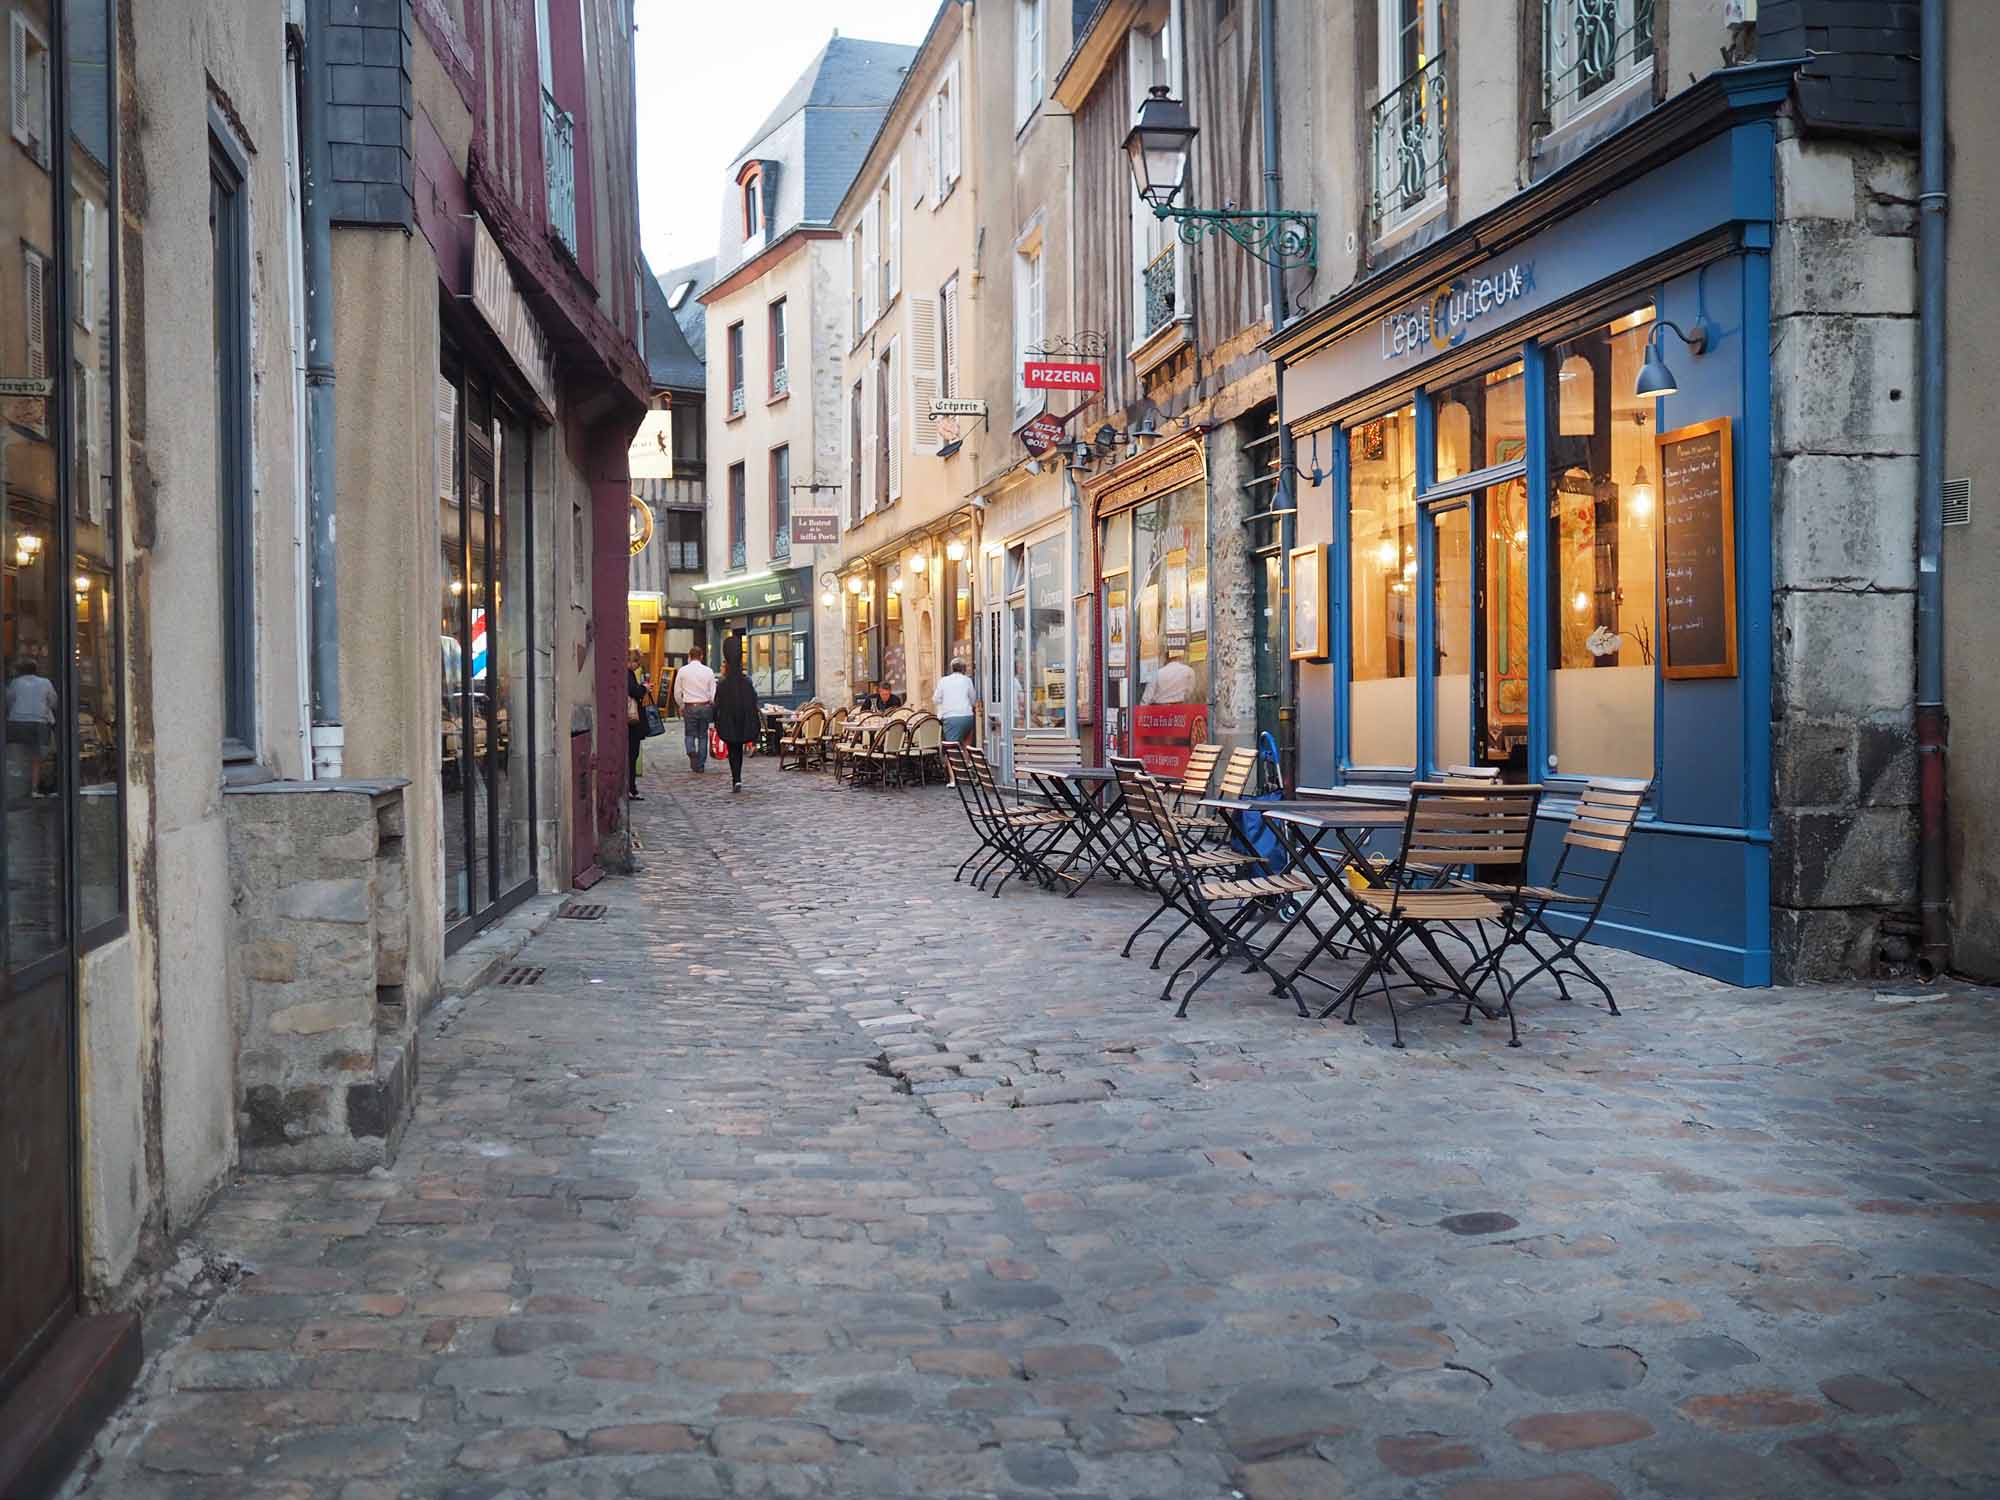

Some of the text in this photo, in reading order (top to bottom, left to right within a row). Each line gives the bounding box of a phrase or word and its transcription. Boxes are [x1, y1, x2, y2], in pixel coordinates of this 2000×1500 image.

[1031, 369, 1096, 383] PIZZERIA
[935, 401, 978, 412] Crêperie
[1034, 422, 1062, 434] PIZZA
[1026, 438, 1048, 449] BOIS
